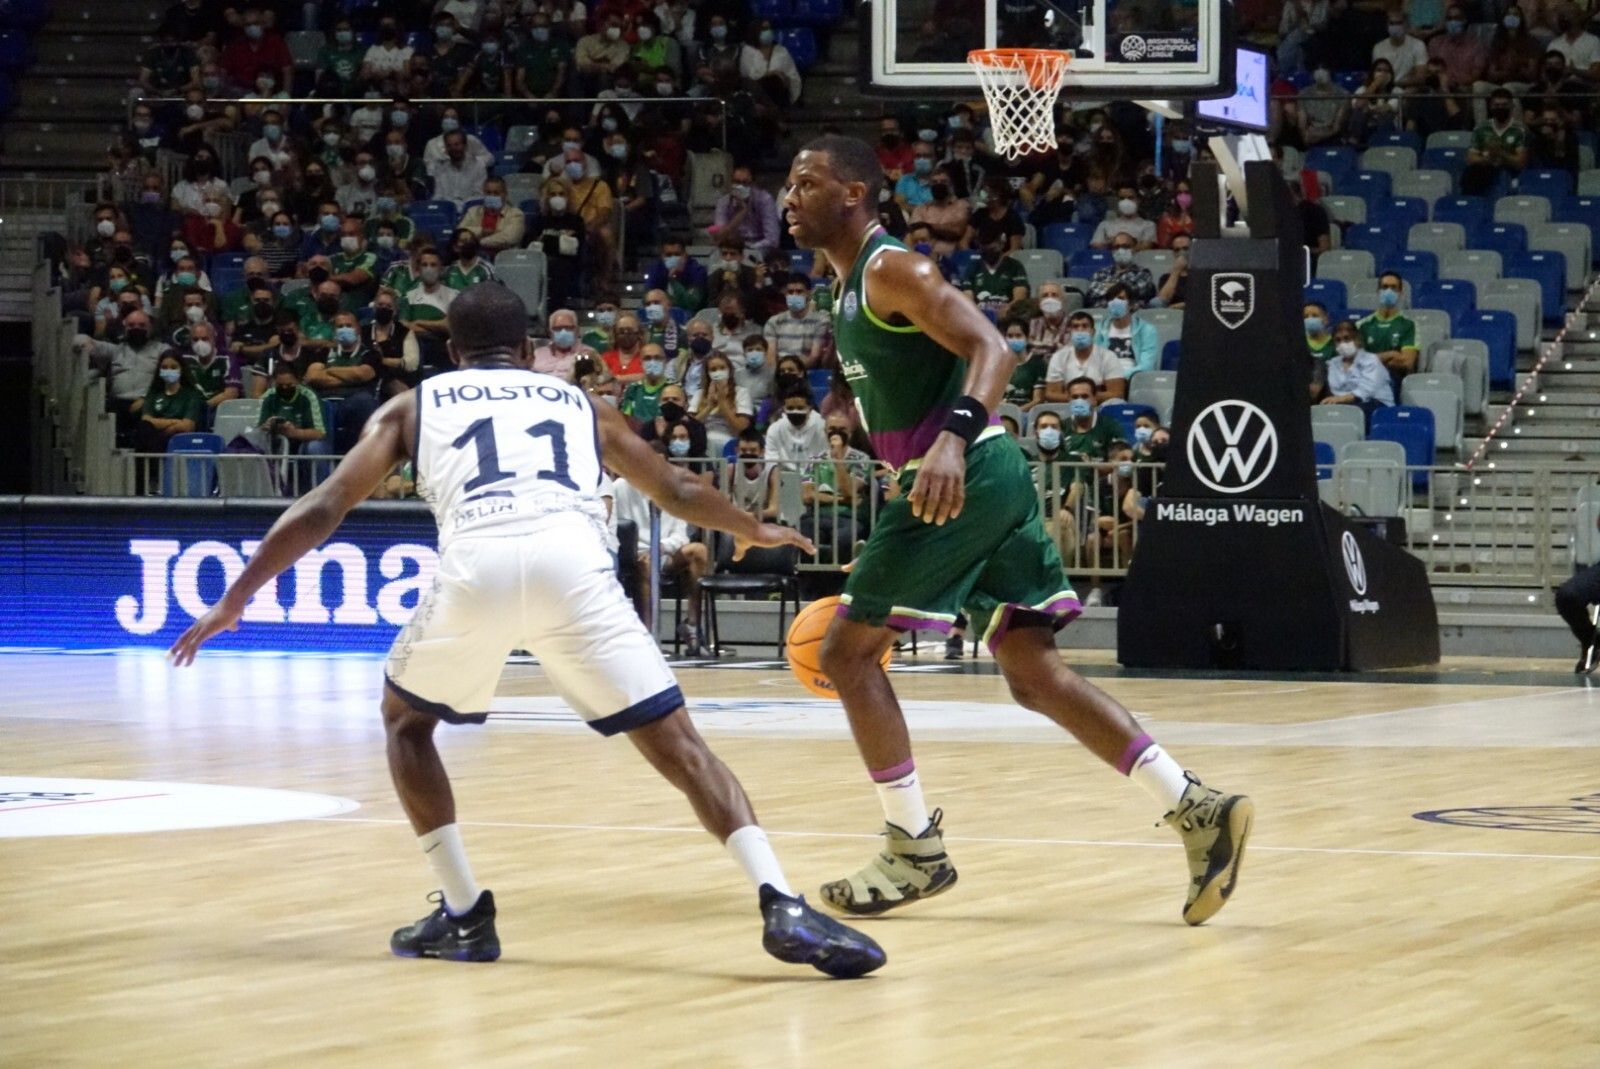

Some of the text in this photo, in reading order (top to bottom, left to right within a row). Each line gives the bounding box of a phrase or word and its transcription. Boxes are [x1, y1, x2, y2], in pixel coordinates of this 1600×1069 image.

[433, 385, 583, 411] HOLSTON
[451, 416, 580, 493] 11
[1157, 503, 1303, 527] Málaga Wagen
